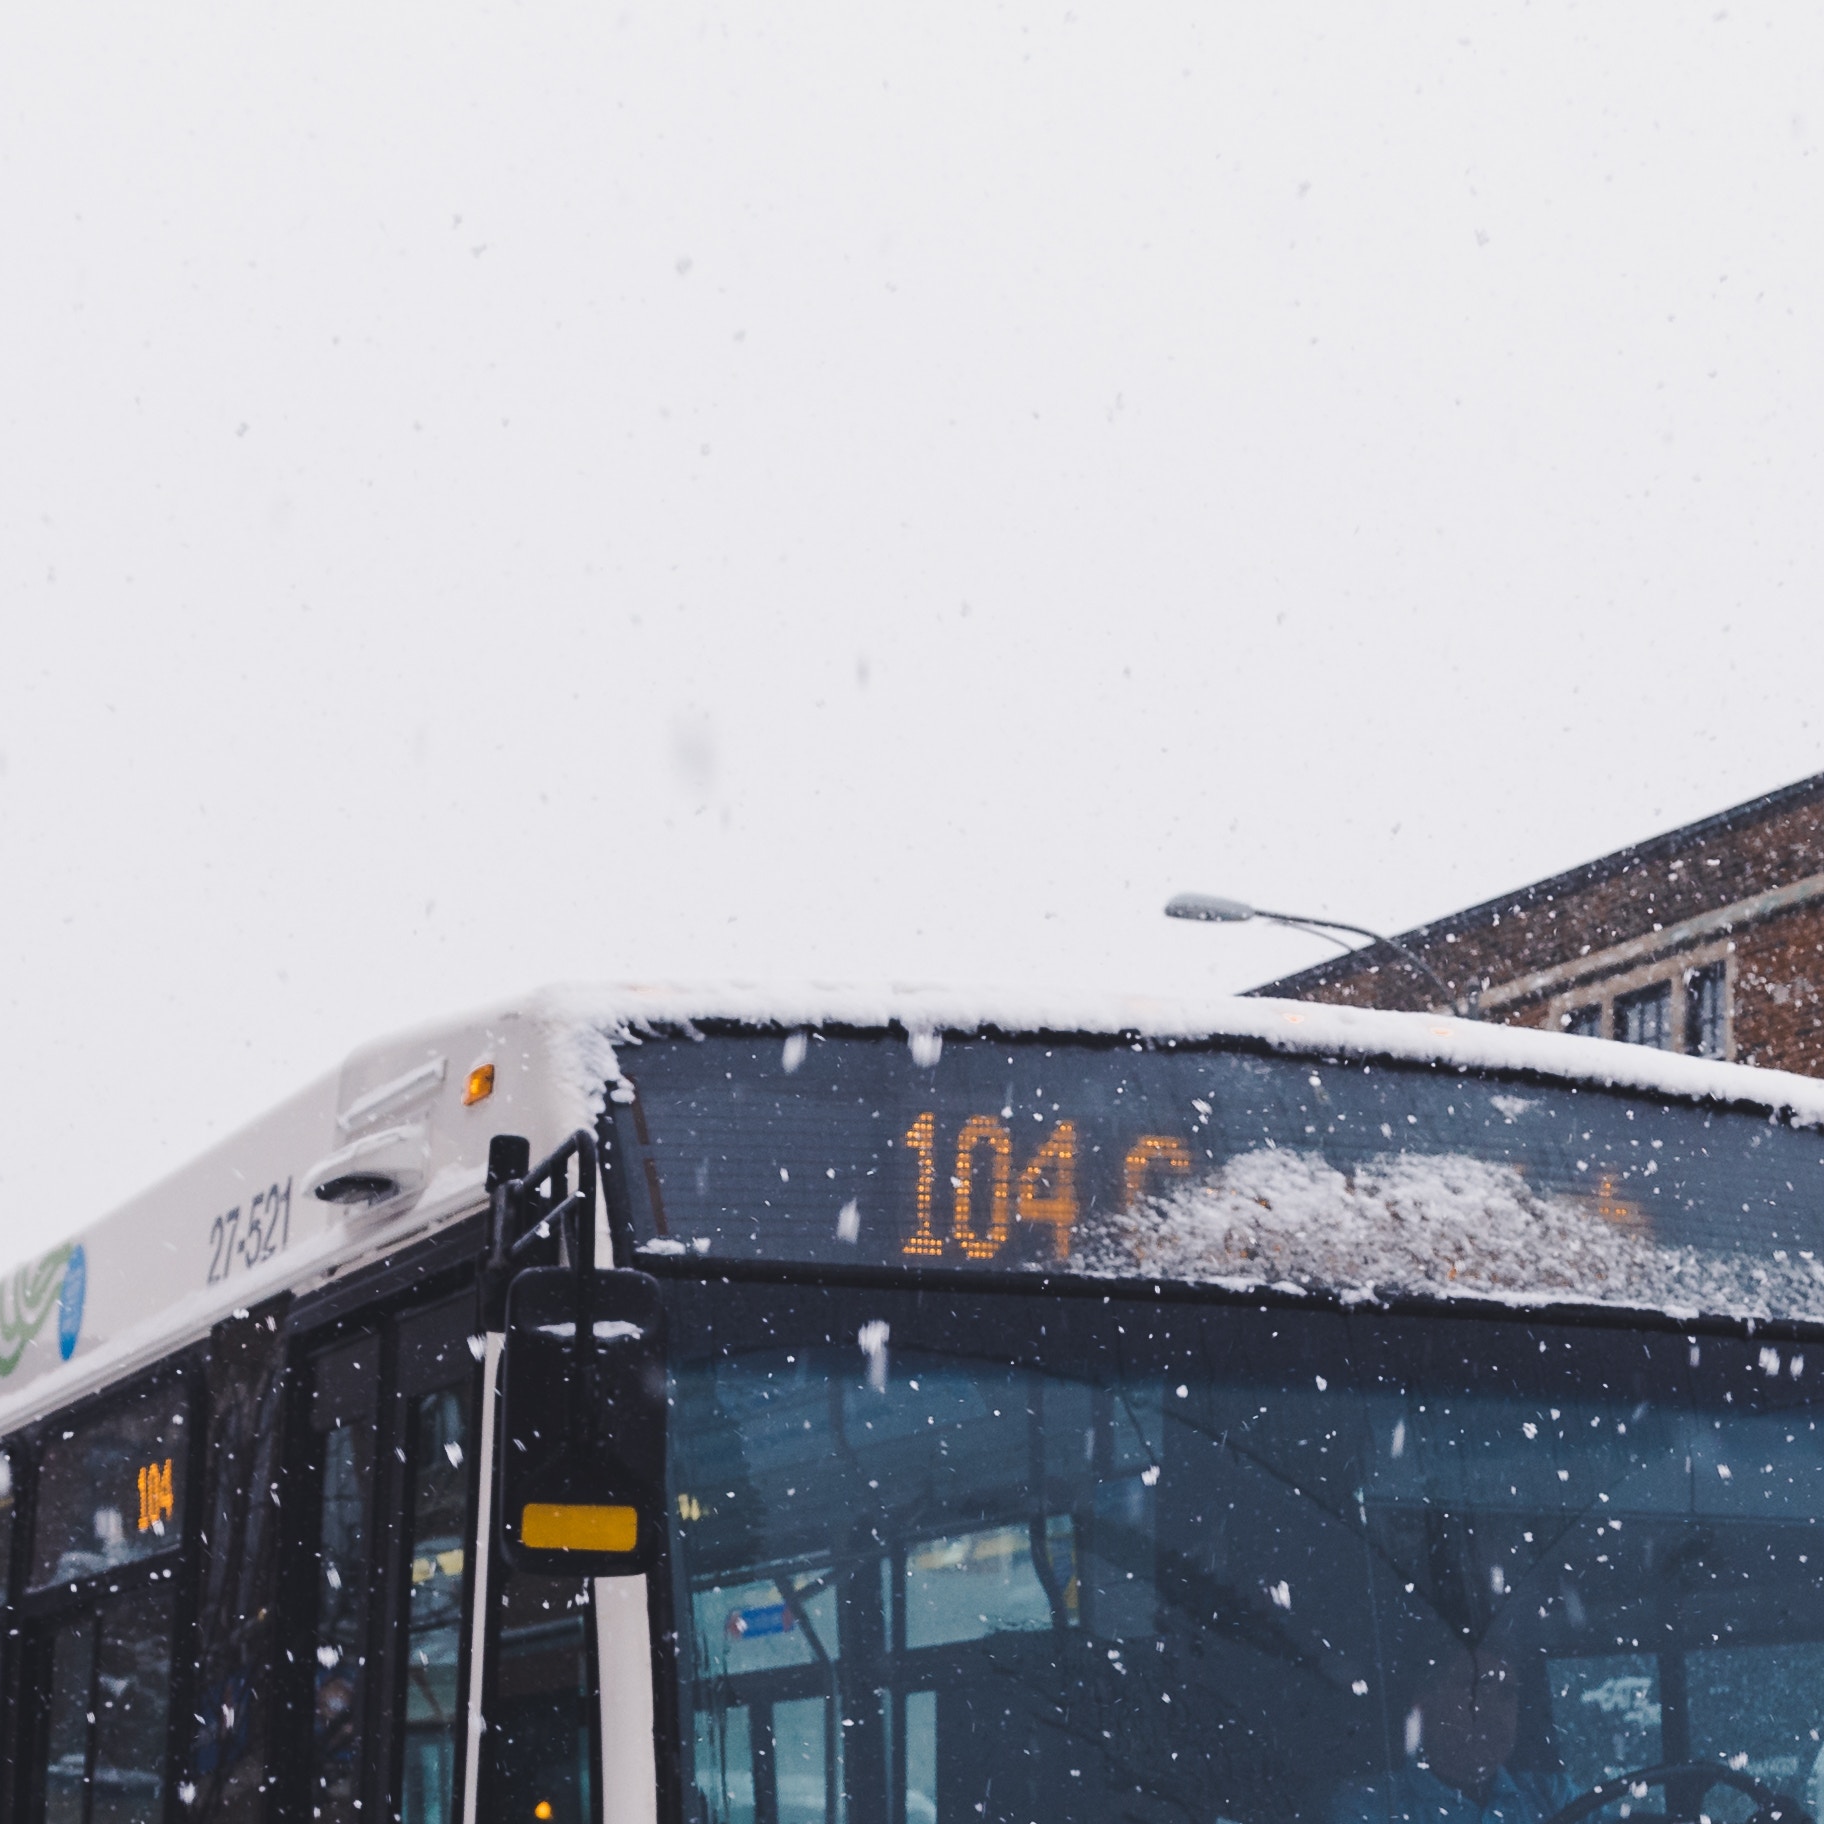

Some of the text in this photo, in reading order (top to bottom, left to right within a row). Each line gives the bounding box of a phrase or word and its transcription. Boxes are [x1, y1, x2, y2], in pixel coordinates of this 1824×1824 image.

[207, 1175, 293, 1286] 27-521
[901, 1111, 1078, 1261] 104
[137, 1458, 174, 1532] 104
